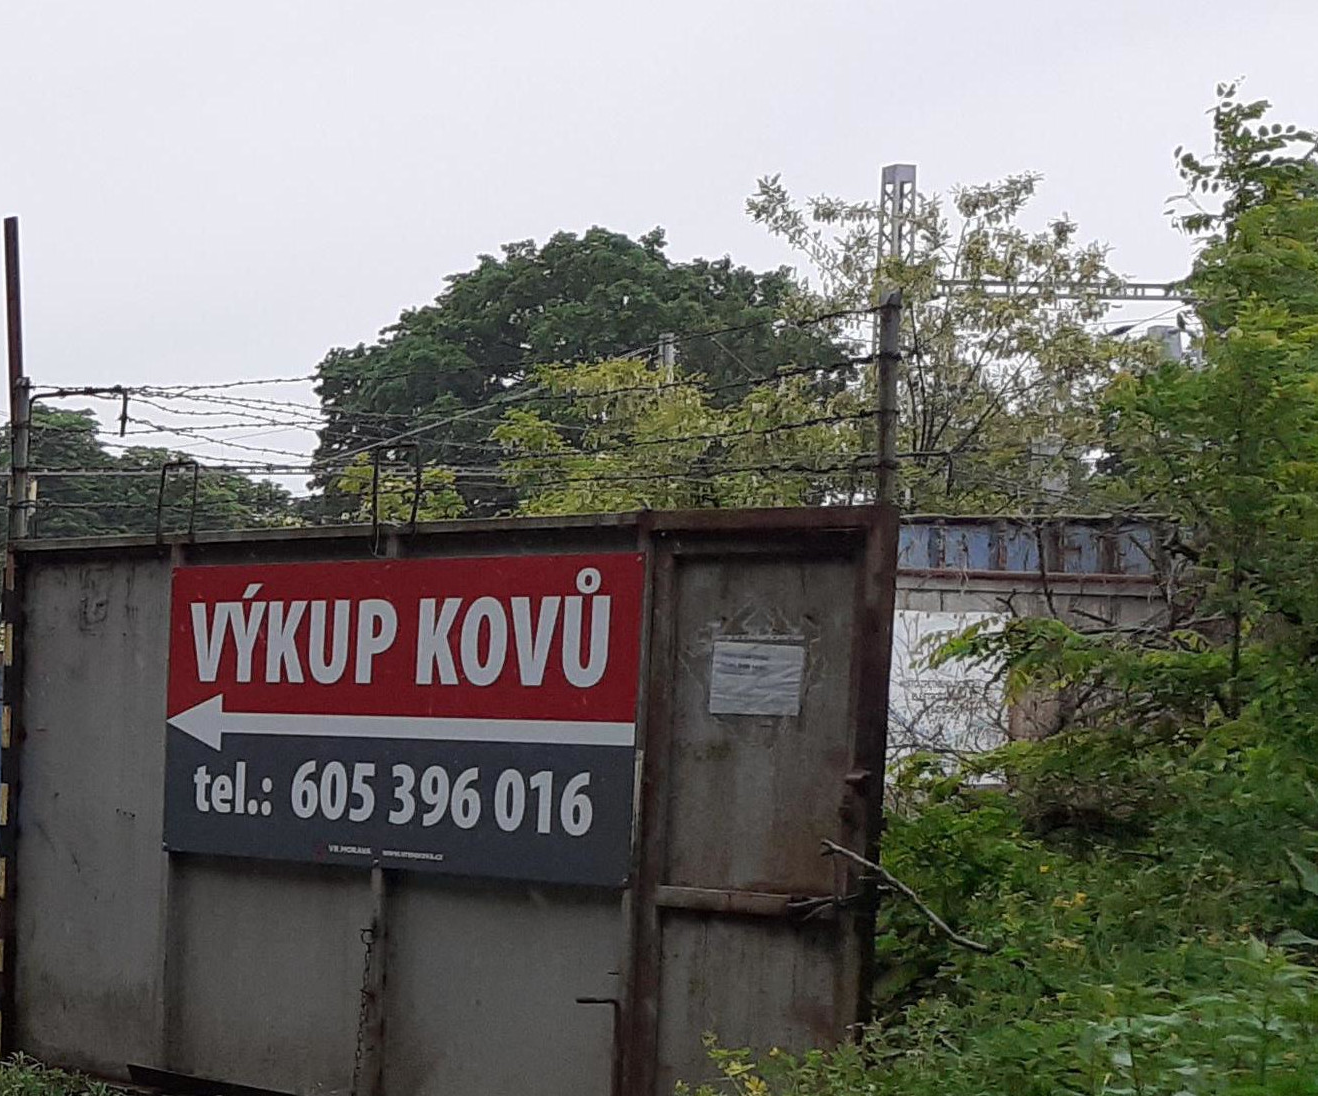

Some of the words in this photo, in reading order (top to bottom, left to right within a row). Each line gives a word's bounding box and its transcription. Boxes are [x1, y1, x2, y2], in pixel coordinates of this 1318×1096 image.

[190, 583, 398, 684] VÝKUP
[416, 567, 611, 688] KOVŮ
[193, 761, 273, 816] tel.:
[291, 760, 375, 822] 605
[388, 764, 481, 829] 396
[494, 768, 593, 836] 016
